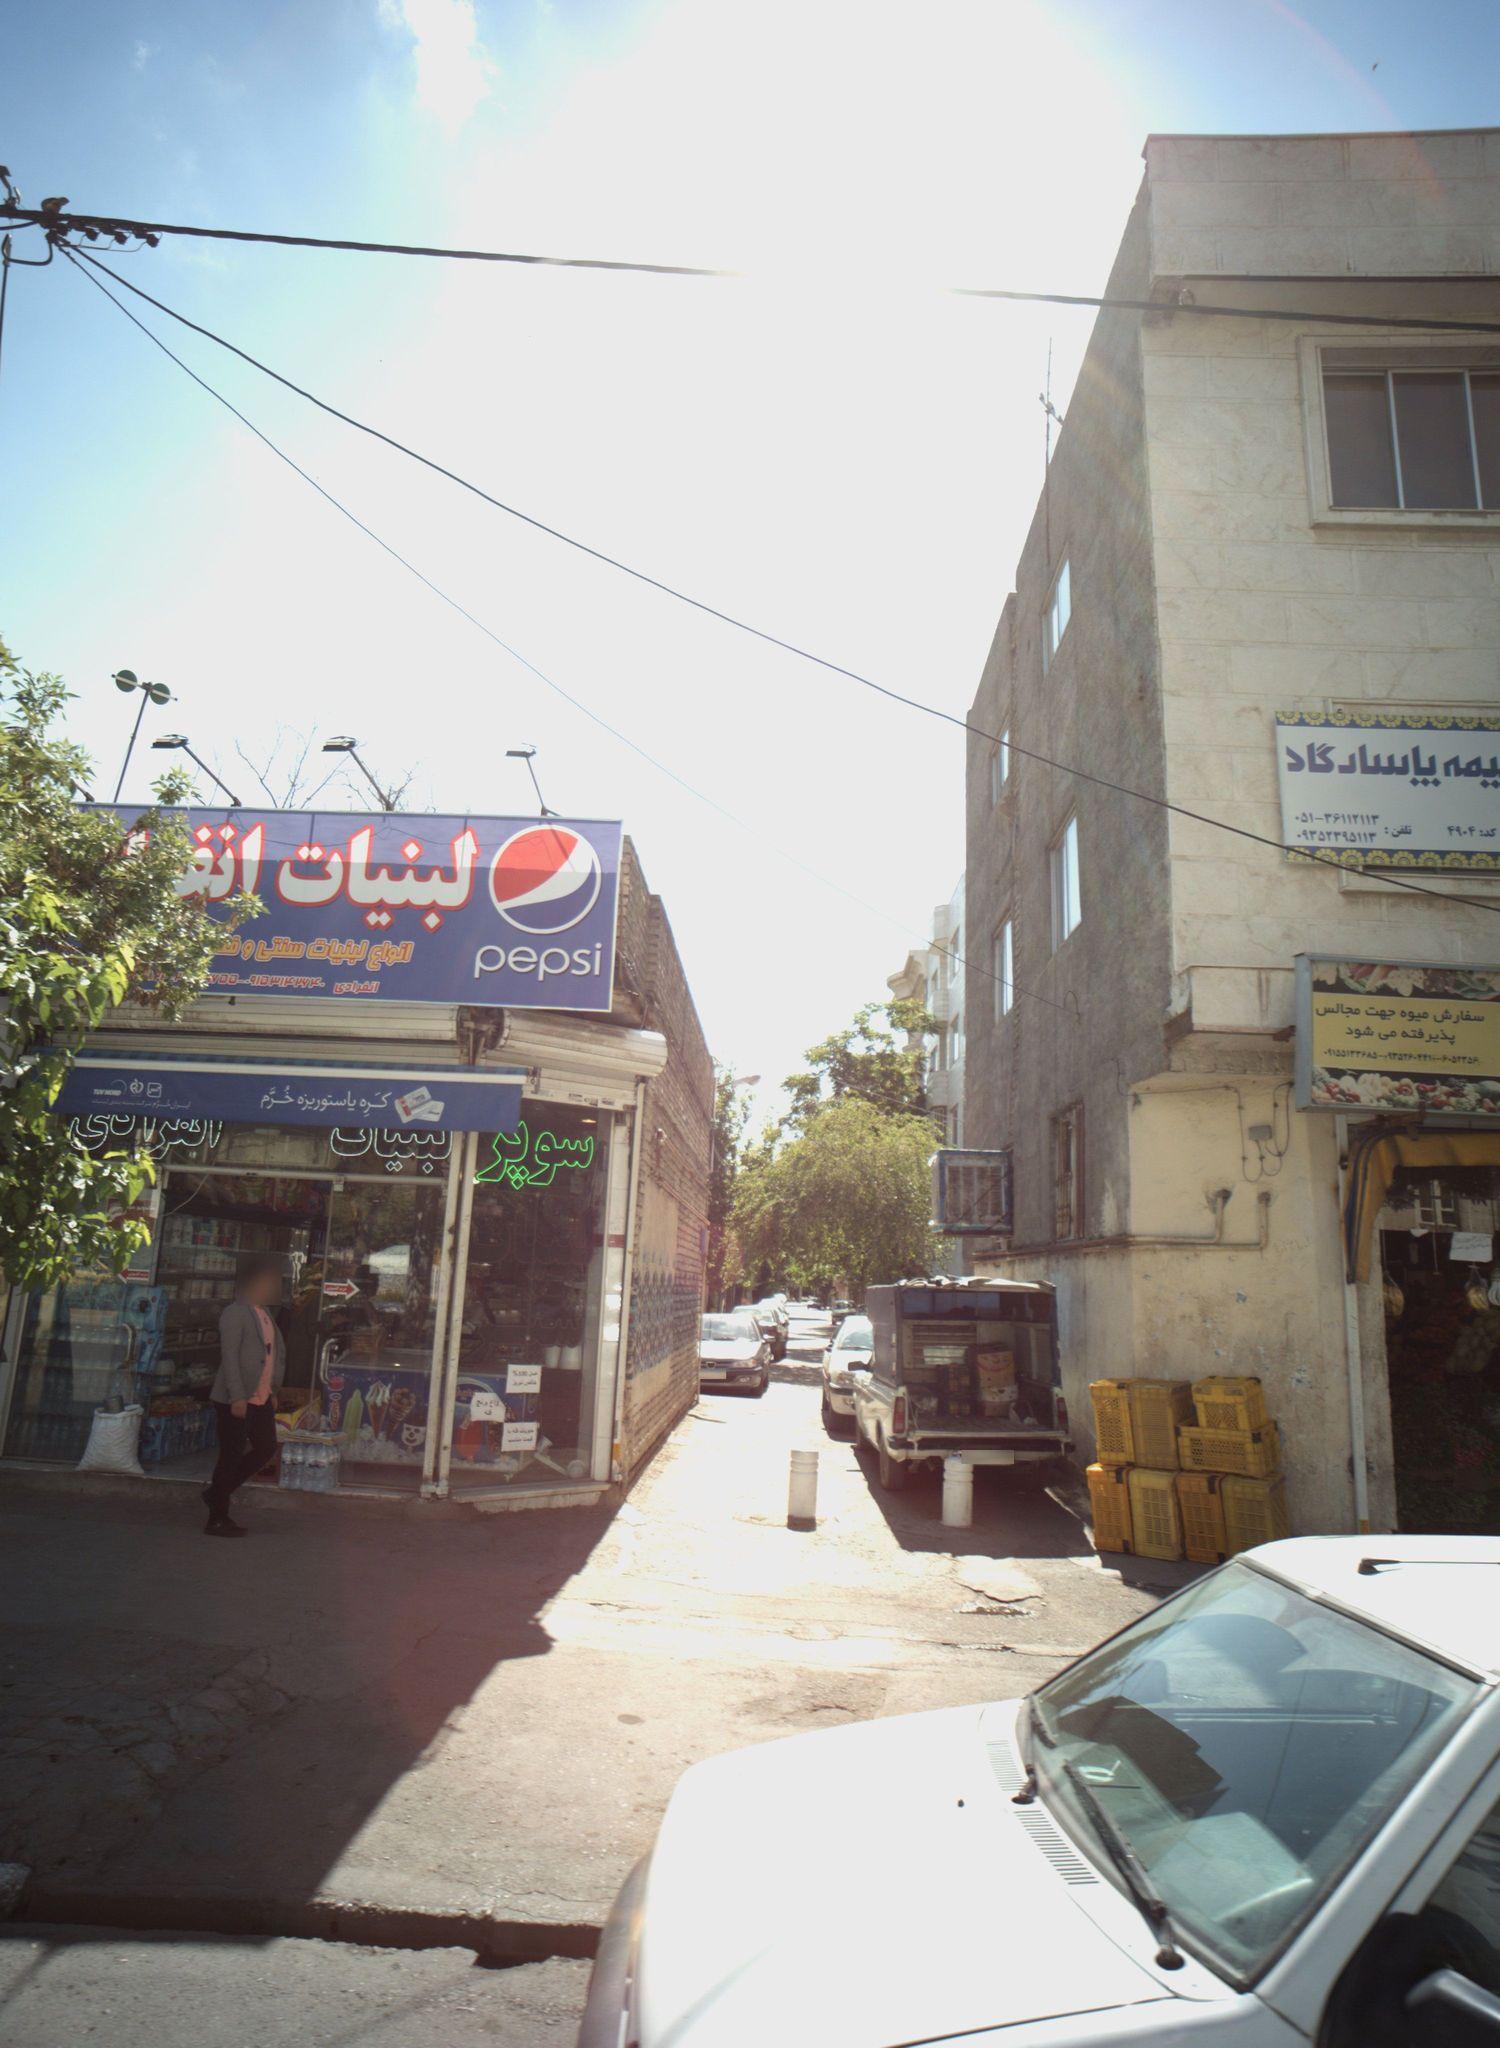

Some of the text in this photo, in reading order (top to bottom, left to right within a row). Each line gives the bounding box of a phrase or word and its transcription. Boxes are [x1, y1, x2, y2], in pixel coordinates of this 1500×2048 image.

[1286, 742, 1500, 788] یمه پاسارگاد
[277, 823, 481, 932] لبنیات
[254, 936, 304, 962] سنتی
[306, 938, 368, 965] لبنیات
[366, 940, 414, 971] انواع
[474, 942, 602, 981] pepsi
[333, 980, 380, 995] انفرادی
[1315, 1003, 1485, 1023] سفارش میوه جهت مجالس
[1345, 1025, 1456, 1045] پذیرفته می شود
[476, 1121, 594, 1189] سوپر
